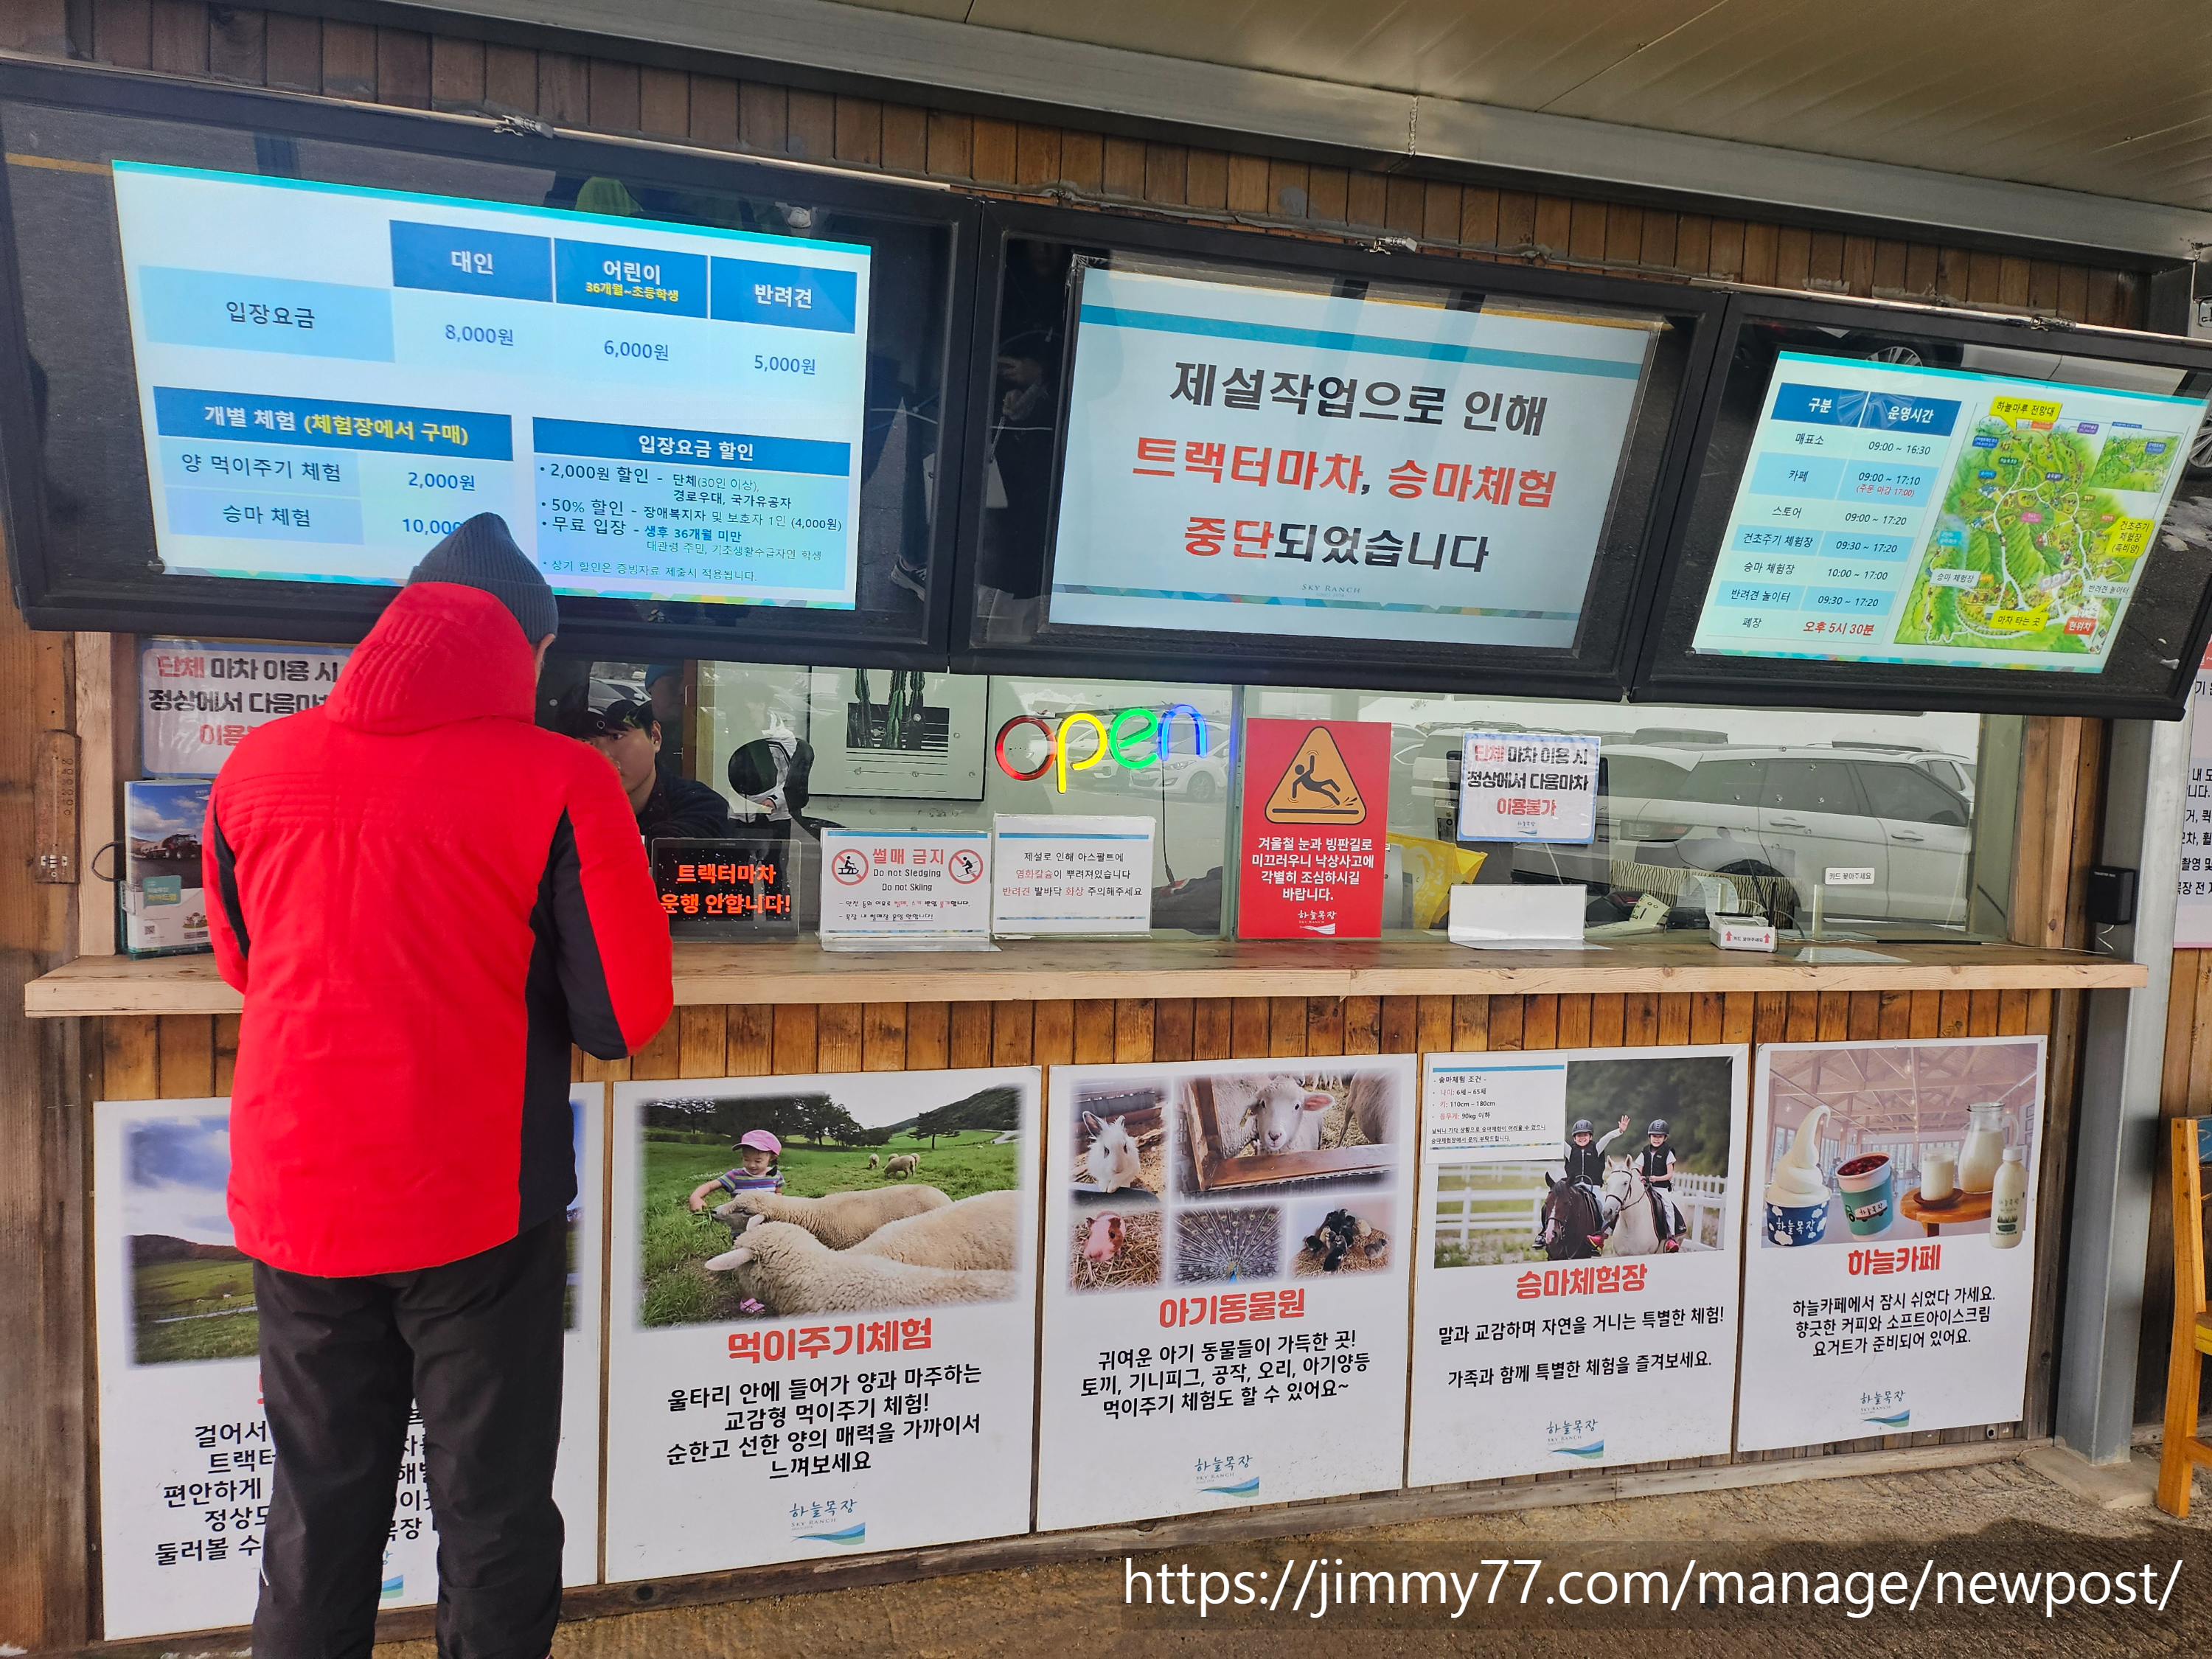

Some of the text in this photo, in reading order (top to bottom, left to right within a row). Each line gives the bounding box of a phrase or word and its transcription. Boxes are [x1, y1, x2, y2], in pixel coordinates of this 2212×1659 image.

[450, 250, 494, 276] 대인
[603, 259, 660, 286] 어린이
[585, 282, 678, 303] 36개월~초등학생
[754, 283, 813, 310] 반려견
[226, 301, 316, 330] 입장요금
[445, 324, 514, 347] 8,000원
[603, 340, 669, 362] 6,000원
[754, 354, 816, 375] 5,000원
[1170, 361, 1548, 436] 제설작업으로 인해
[1808, 397, 1832, 414] 구분
[1888, 406, 1933, 424] 운영시간
[1997, 401, 2056, 417] 하늘마루 전망대
[204, 406, 468, 446] 개별 체험 (체험장에서 구매)
[639, 435, 754, 462] 입장요금 할인
[1795, 433, 1823, 445] 매표소
[1868, 441, 1930, 456] 09:00 16:30
[181, 454, 341, 482] 양 먹이주기 체험
[551, 464, 648, 484] 2,000원 할인
[1133, 437, 1557, 509] 트랙터마차, 승마체험
[1789, 470, 1808, 481] 카페
[408, 472, 475, 492] 2,000원
[1859, 472, 1920, 486] 09:00 17:10
[673, 490, 791, 509] 경로우대, 국가유공자
[222, 504, 310, 527] 승마 체험
[1772, 507, 1801, 518] 스토어
[1845, 512, 1906, 526] 09:00 17:20
[1184, 516, 1489, 573] 중단되었습니다
[1743, 532, 1813, 548] 건초주기 체험장
[1744, 562, 1795, 575] 승마 체험장
[1828, 568, 1888, 580] 10:00 17:00
[1953, 574, 1974, 582] 체험장
[1731, 589, 1790, 603] 반려견 놀이터
[1742, 618, 1761, 628] 폐장
[1803, 621, 1874, 636] 오후 5시 30분
[1997, 616, 2041, 627] 마차 타는 곳
[2069, 622, 2092, 631] 현위치
[157, 655, 338, 683] 단체 마차 이용 시
[148, 689, 243, 713] 정상에서
[995, 704, 1208, 793] open
[1475, 745, 1588, 766] 단체 마차 이용 시
[1467, 771, 1588, 792] 정상에서 다음마차
[1497, 797, 1557, 816] 이용불가
[1258, 837, 1373, 852] 겨울철 눈과 빙판길로
[873, 849, 943, 864] 썰매 금지
[1024, 852, 1124, 862] 제설로 인해 아스팔트에
[1252, 854, 1374, 869] 미끄러우니 낙상사고에
[677, 863, 776, 884] 트랙터마차
[905, 869, 941, 877] Sledging
[1262, 870, 1360, 886] 각별히 조심하시길
[910, 883, 932, 891] Skiing
[1003, 886, 1142, 897] 반려견 발바닥 화상 주의해주세요
[1282, 887, 1333, 902] 바랍니다.
[661, 894, 790, 914] 운행 안합니다!
[1298, 910, 1337, 919] 하늘목장
[1439, 1076, 1465, 1084] 승마체험
[1860, 1203, 1883, 1216] 하늘목장
[1775, 1218, 1815, 1234] 하늘목장
[1848, 1244, 1941, 1275] 하늘카페
[1517, 1263, 1647, 1299] 승마체험장
[1160, 1289, 1304, 1328] 아기동물원
[1793, 1286, 1995, 1317] 하늘카페에서 잠시 쉬었다 가세요.
[1439, 1306, 1724, 1346] 말과 교감하며 자연을 거니는 특별한 체험!
[728, 1317, 932, 1363] 먹이주기체험
[1812, 1329, 1971, 1357] 요거트가 준비되어 있어요.
[1099, 1330, 1355, 1371] 귀여운 아기 동물들이 가득한 곳!
[1860, 1390, 1906, 1405] 하늘목장
[724, 1393, 929, 1432] 교감형 먹이주기 체험!
[195, 1421, 266, 1448] 걸어서
[1546, 1419, 1599, 1434] 하늘목장
[769, 1451, 871, 1479] 느껴보세요
[1194, 1455, 1253, 1472] 하늘목장
[164, 1478, 260, 1508] 편안하게
[789, 1499, 857, 1517] 하늘목장
[155, 1535, 261, 1566] 둘러볼 수
